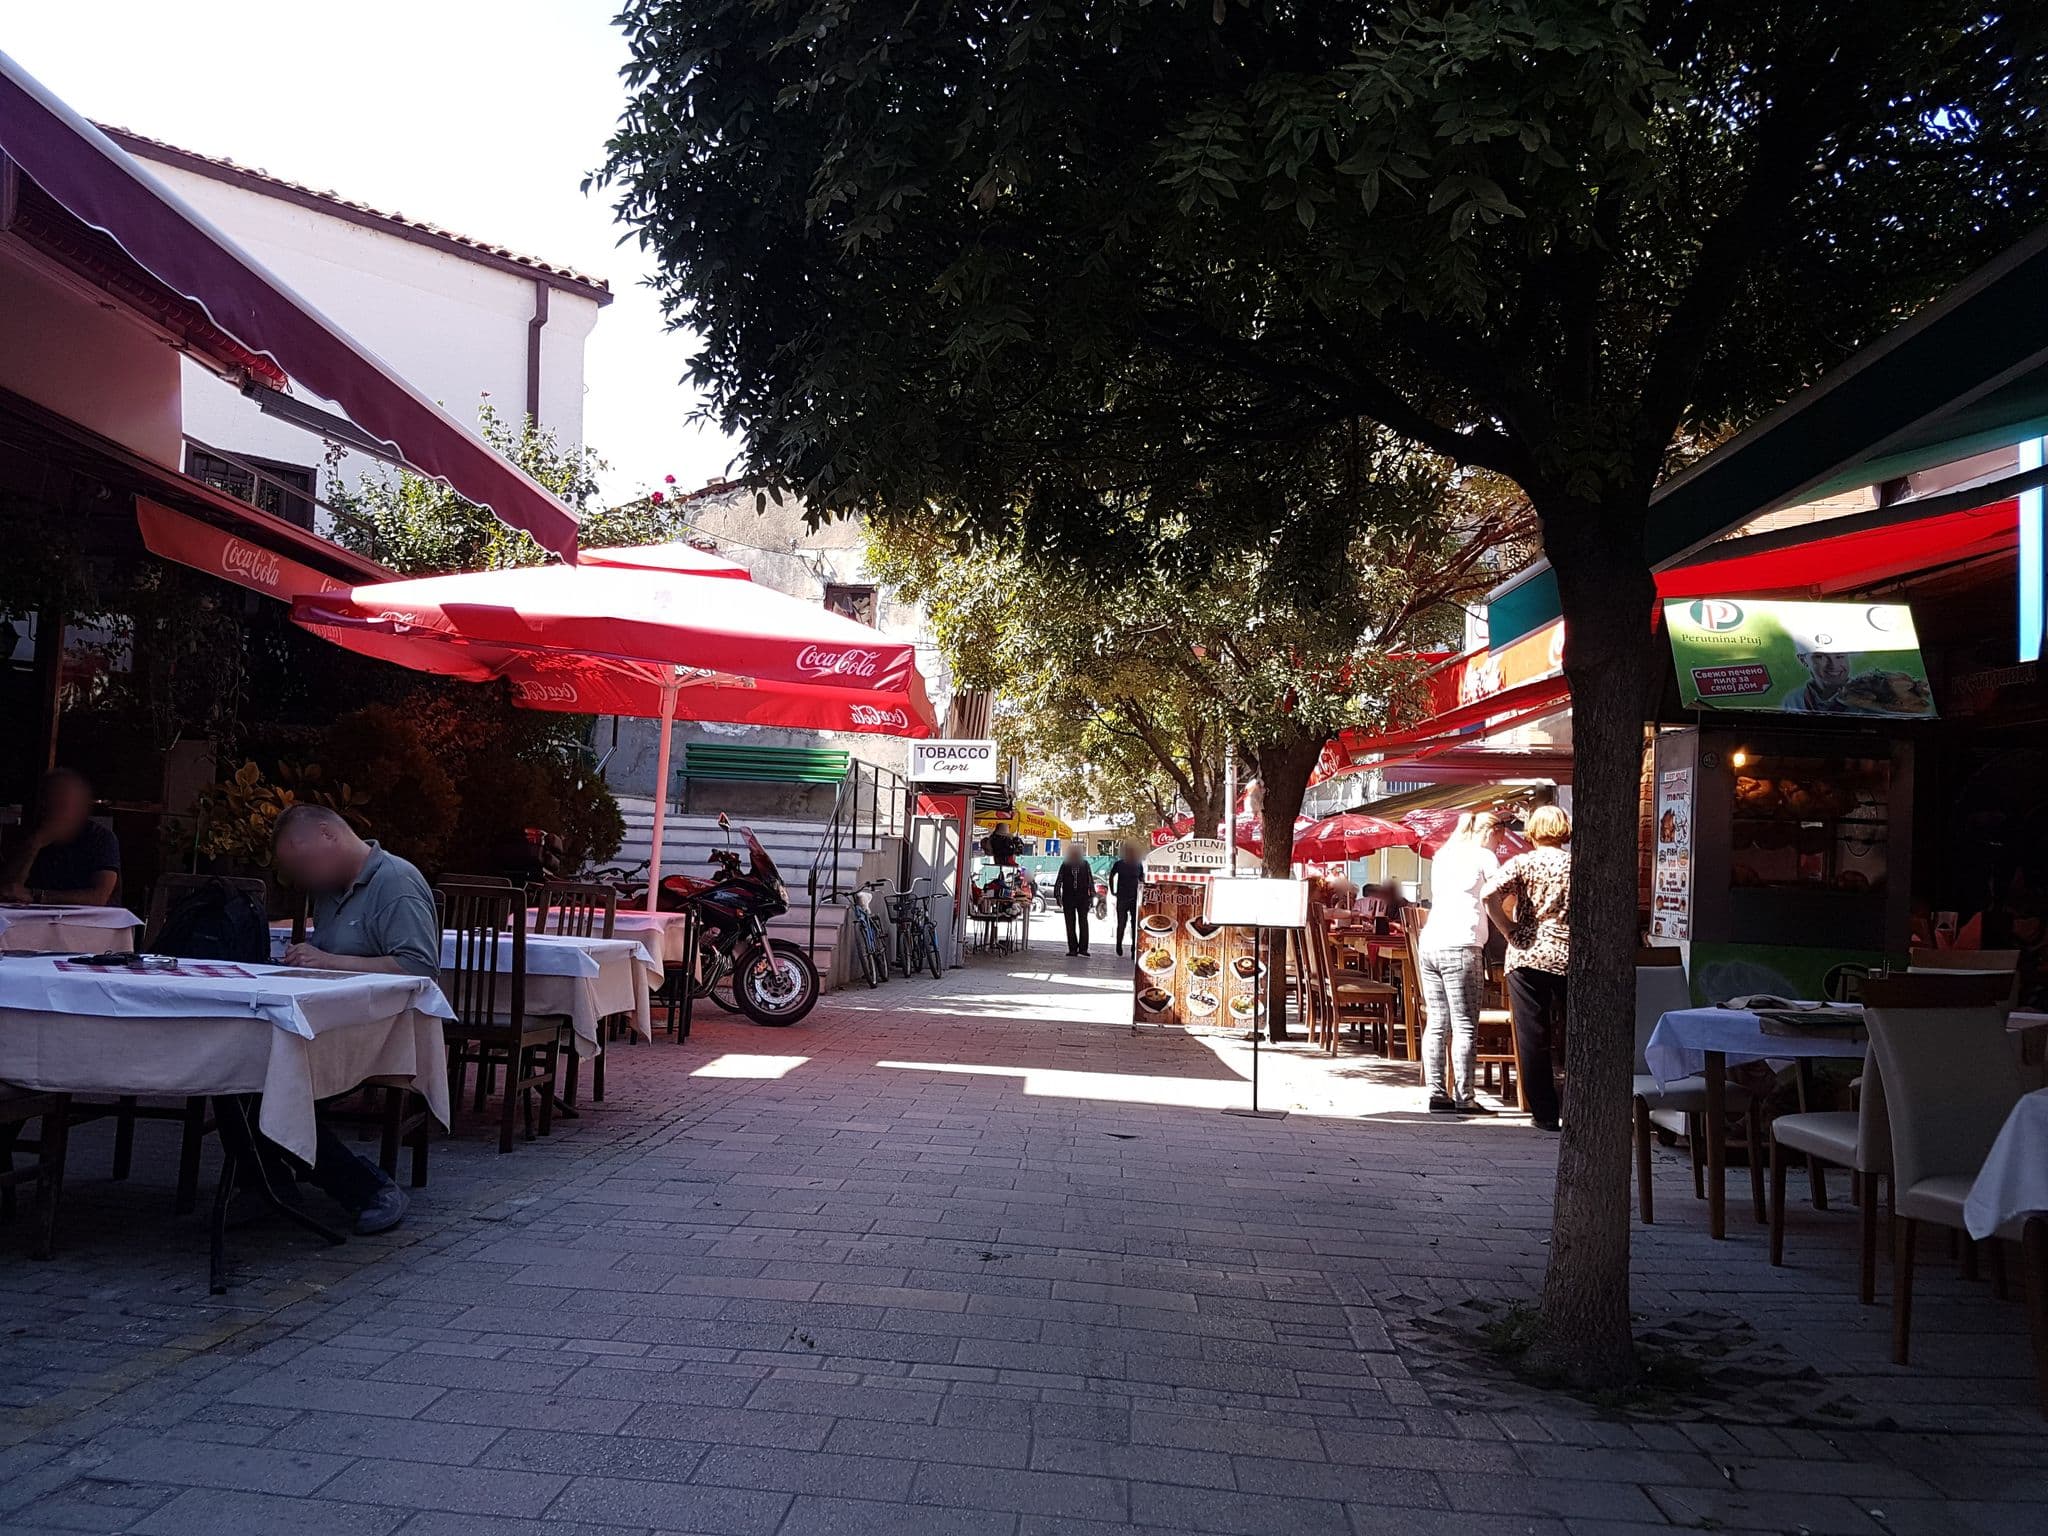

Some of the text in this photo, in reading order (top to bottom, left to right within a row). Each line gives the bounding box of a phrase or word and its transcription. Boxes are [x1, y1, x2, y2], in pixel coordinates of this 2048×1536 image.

[222, 538, 280, 586] Coca-Cola
[1682, 634, 1762, 647] Perutnina Ptuj
[796, 645, 881, 678] Coca-Cola
[1695, 668, 1763, 679] Свежо печено
[1711, 683, 1758, 692] секој дом
[1713, 677, 1737, 685] пиле
[917, 747, 989, 759] TOBACCO
[933, 760, 969, 774] Capri
[1167, 840, 1227, 854] GOSTILNI
